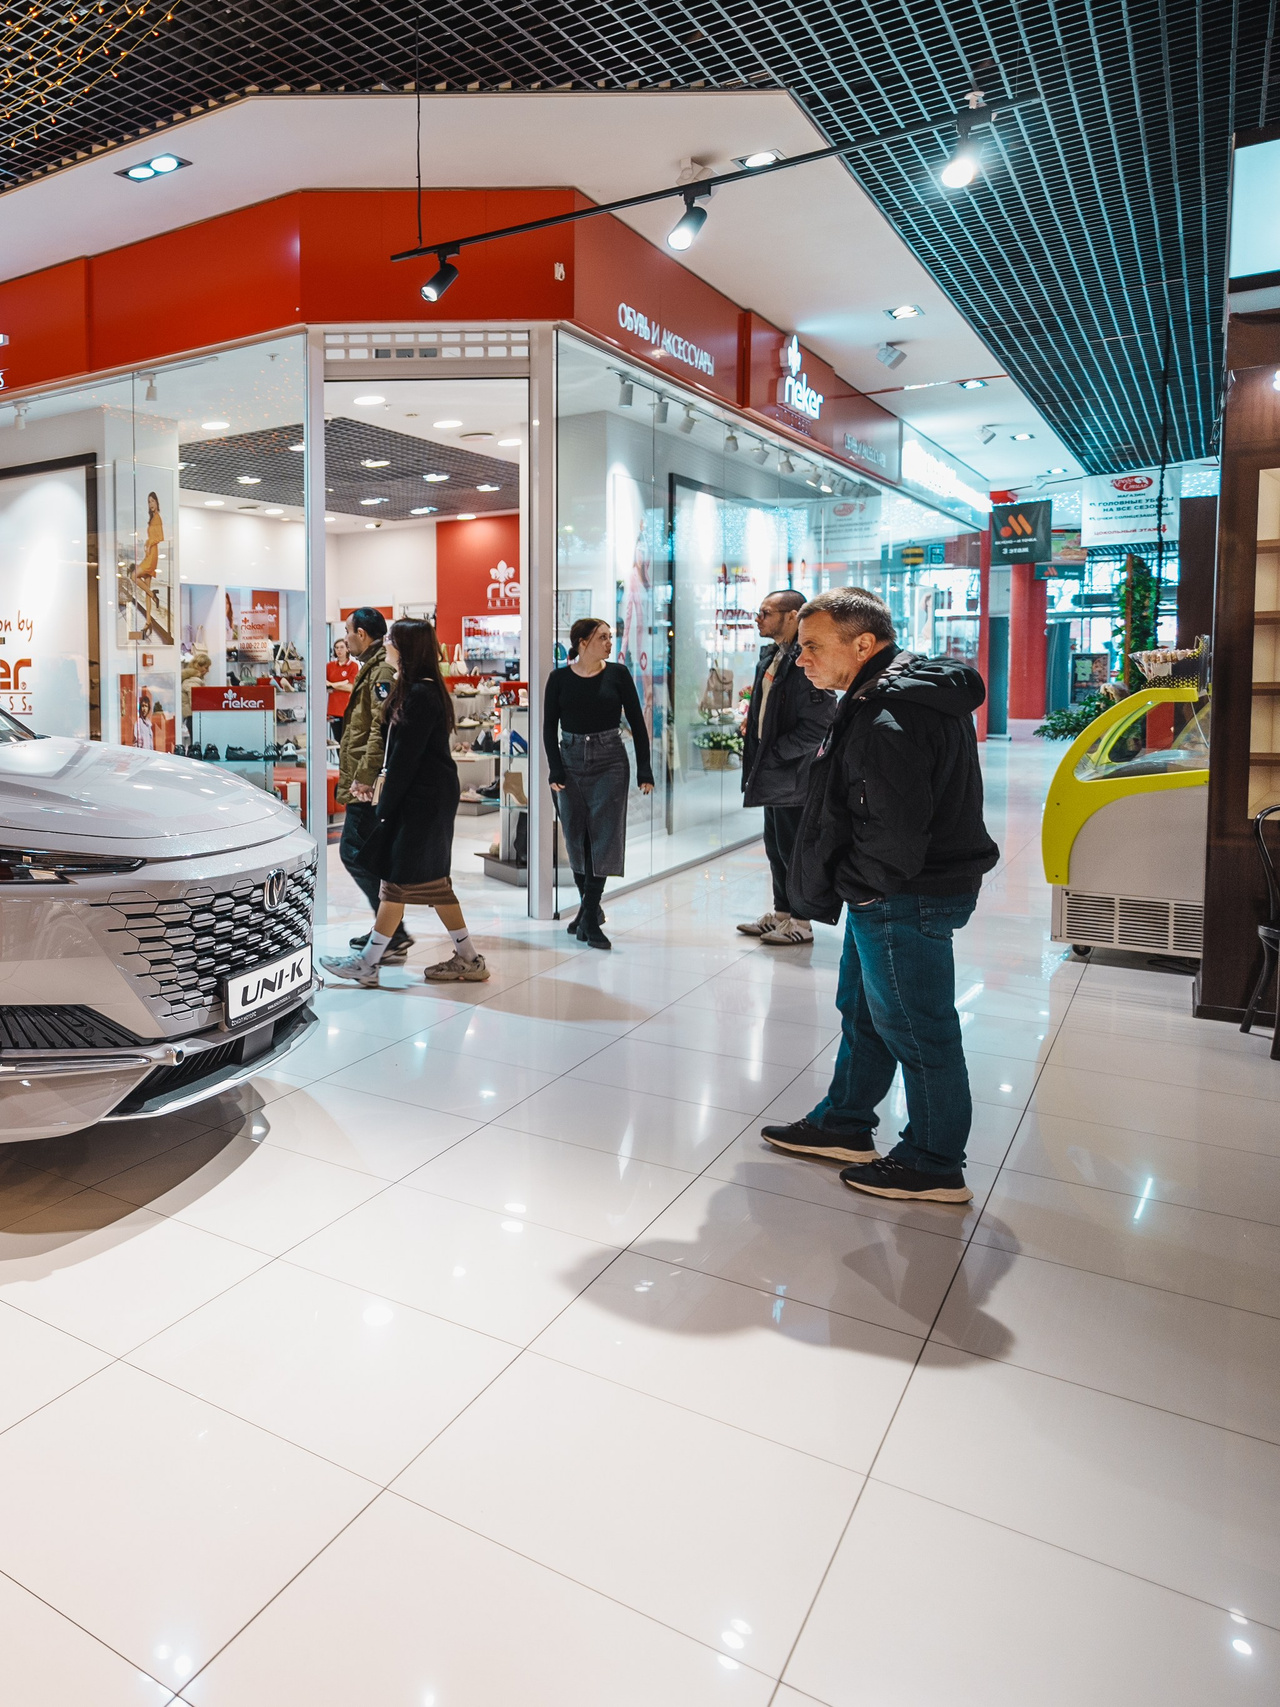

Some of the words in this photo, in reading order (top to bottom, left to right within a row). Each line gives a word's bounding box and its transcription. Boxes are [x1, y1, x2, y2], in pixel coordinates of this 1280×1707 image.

[618, 302, 651, 341] ОБУВЬ
[651, 321, 661, 347] И
[660, 328, 716, 377] АКСЕССУАРЫ
[784, 372, 824, 420] rieker
[1098, 498, 1143, 507] ГОЛОВНЫЕ
[17, 610, 33, 642] by
[222, 697, 264, 709] rieker
[241, 957, 304, 1007] UNI-K
